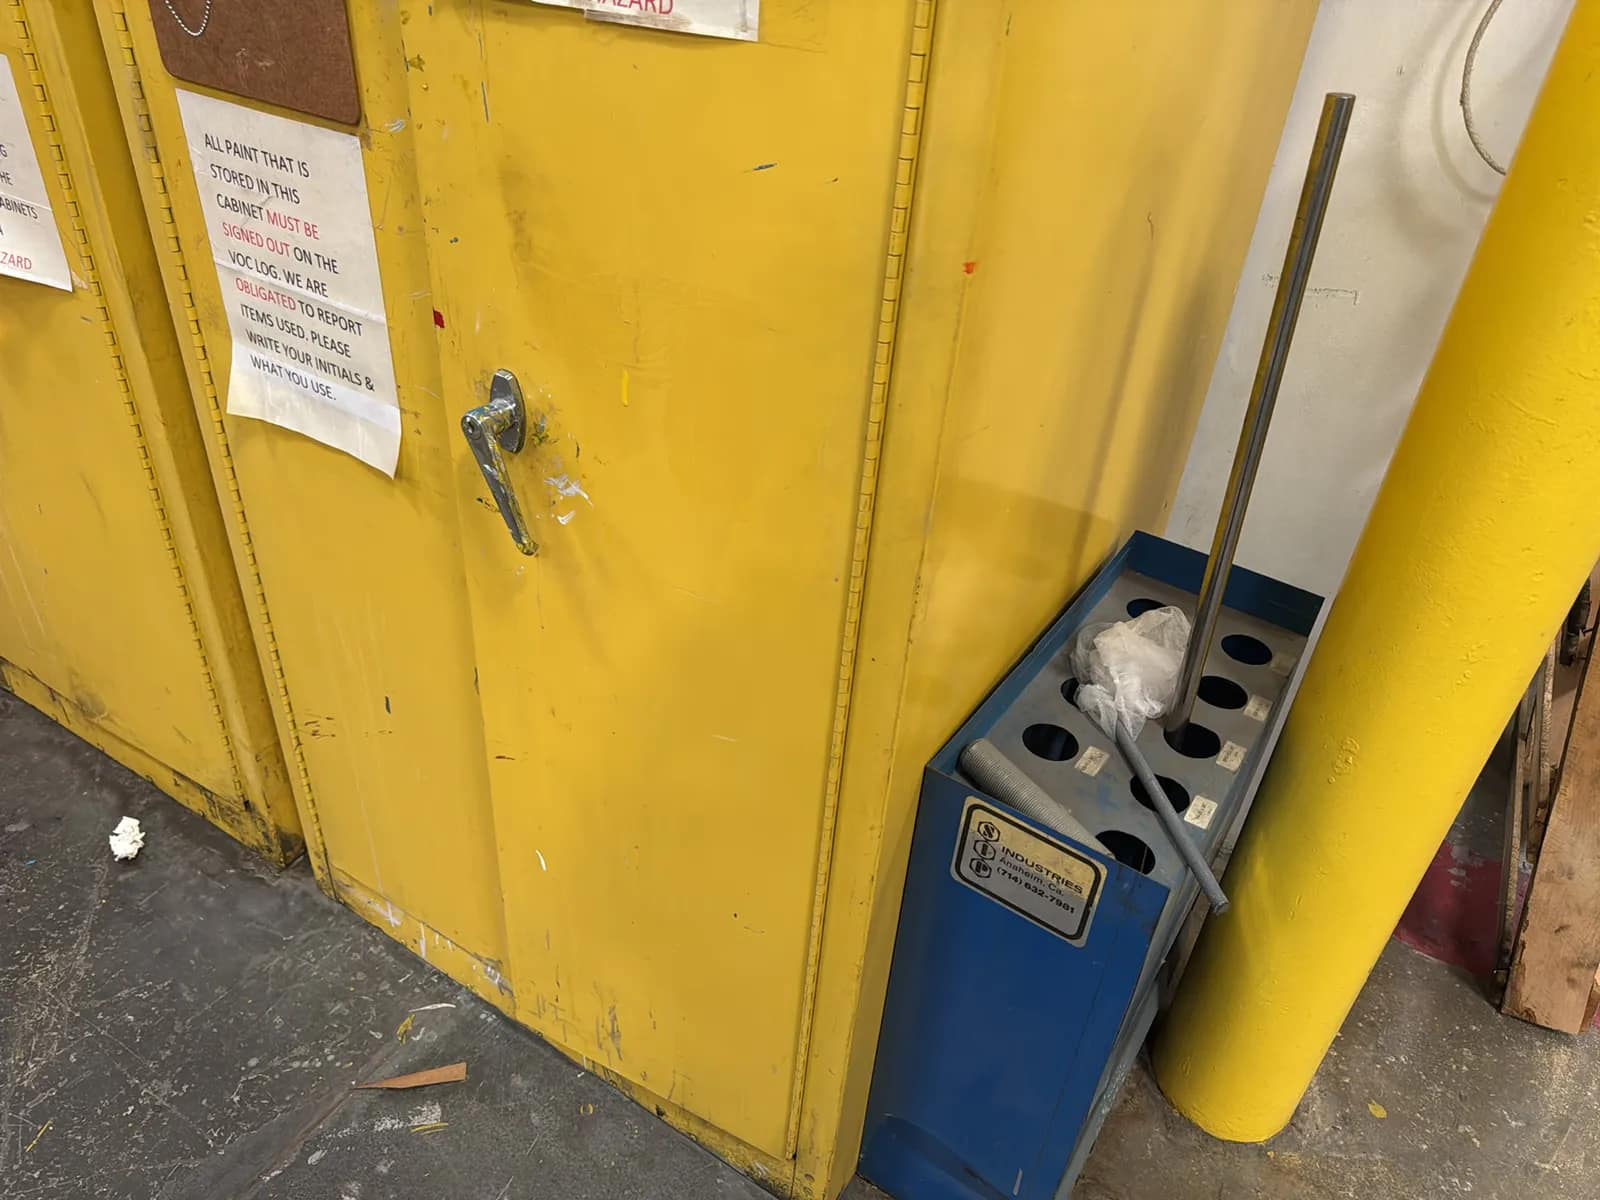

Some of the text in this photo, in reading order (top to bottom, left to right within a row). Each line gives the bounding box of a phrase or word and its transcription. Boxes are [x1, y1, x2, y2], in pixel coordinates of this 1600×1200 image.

[204, 133, 310, 178] ALL PAINT THAT IS
[210, 163, 301, 205] STORED IN THIS
[0, 197, 38, 219] ABINETS
[216, 193, 320, 240] CABINET MUST BE
[222, 222, 340, 274] SIGNED OUT ON THE
[228, 250, 329, 298] VOC LOG. WE ARE
[235, 277, 363, 337] OBLIGATED TO REPORT
[240, 303, 352, 358] ITEMS USED. PLEASE
[245, 328, 375, 392] WRITE YOUR INITIALS &
[250, 354, 337, 401] WHAT YOU USE.
[997, 866, 1023, 885] (714)
[1001, 846, 1083, 895] INDUSTRIES
[1047, 882, 1065, 896] Ca.
